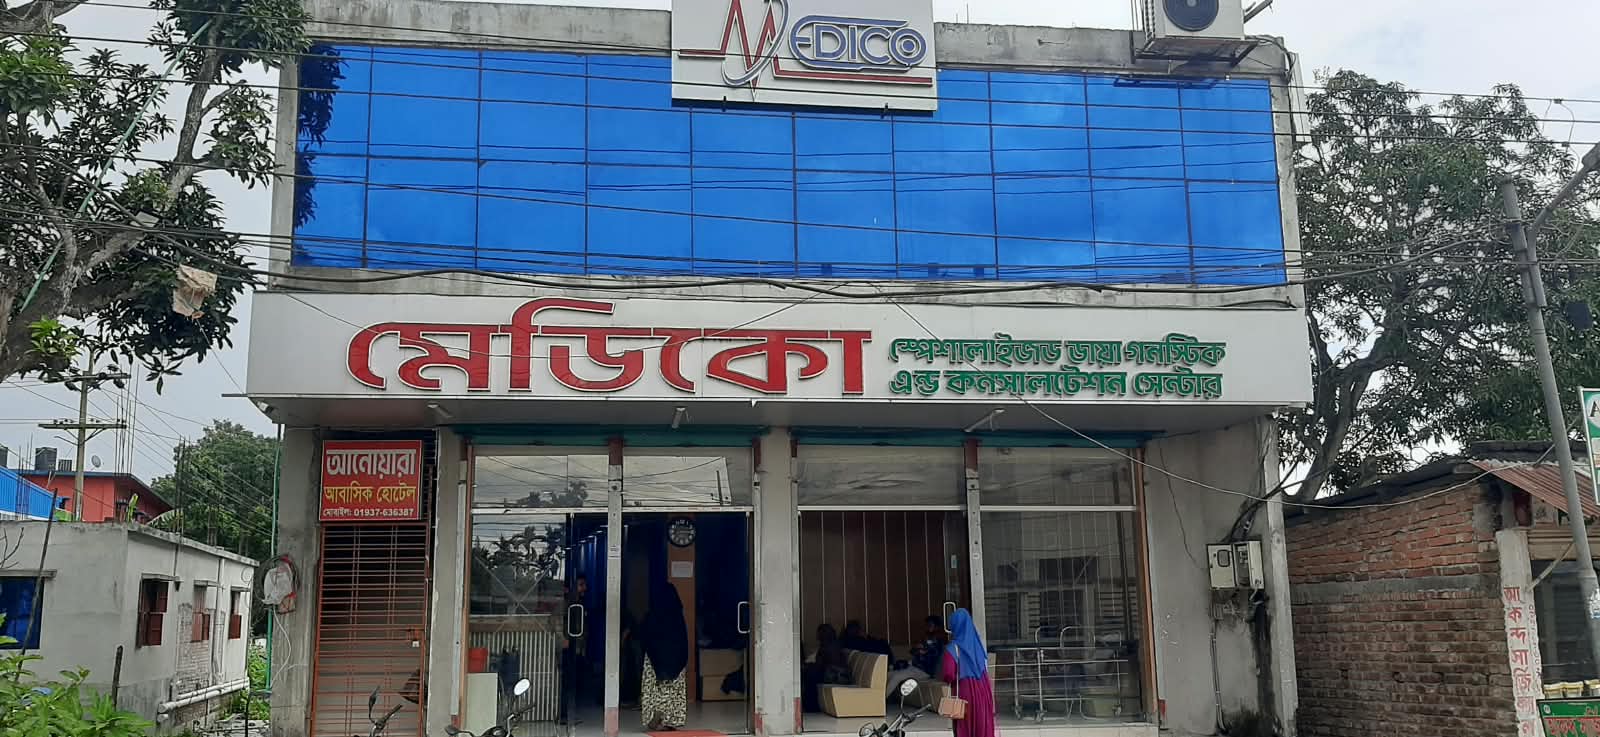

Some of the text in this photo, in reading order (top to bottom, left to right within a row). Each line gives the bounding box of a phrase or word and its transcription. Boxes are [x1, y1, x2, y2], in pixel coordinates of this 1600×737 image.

[720, 0, 927, 100] MEDICO
[346, 297, 872, 395] মেডিকো
[889, 333, 1061, 367] স্পেশালাইজড
[889, 365, 1223, 398] এন্ড কনসালটেশন সেন্টার
[326, 449, 416, 479] আনোয়ারা
[324, 480, 416, 504] আবাসিক হোটেল
